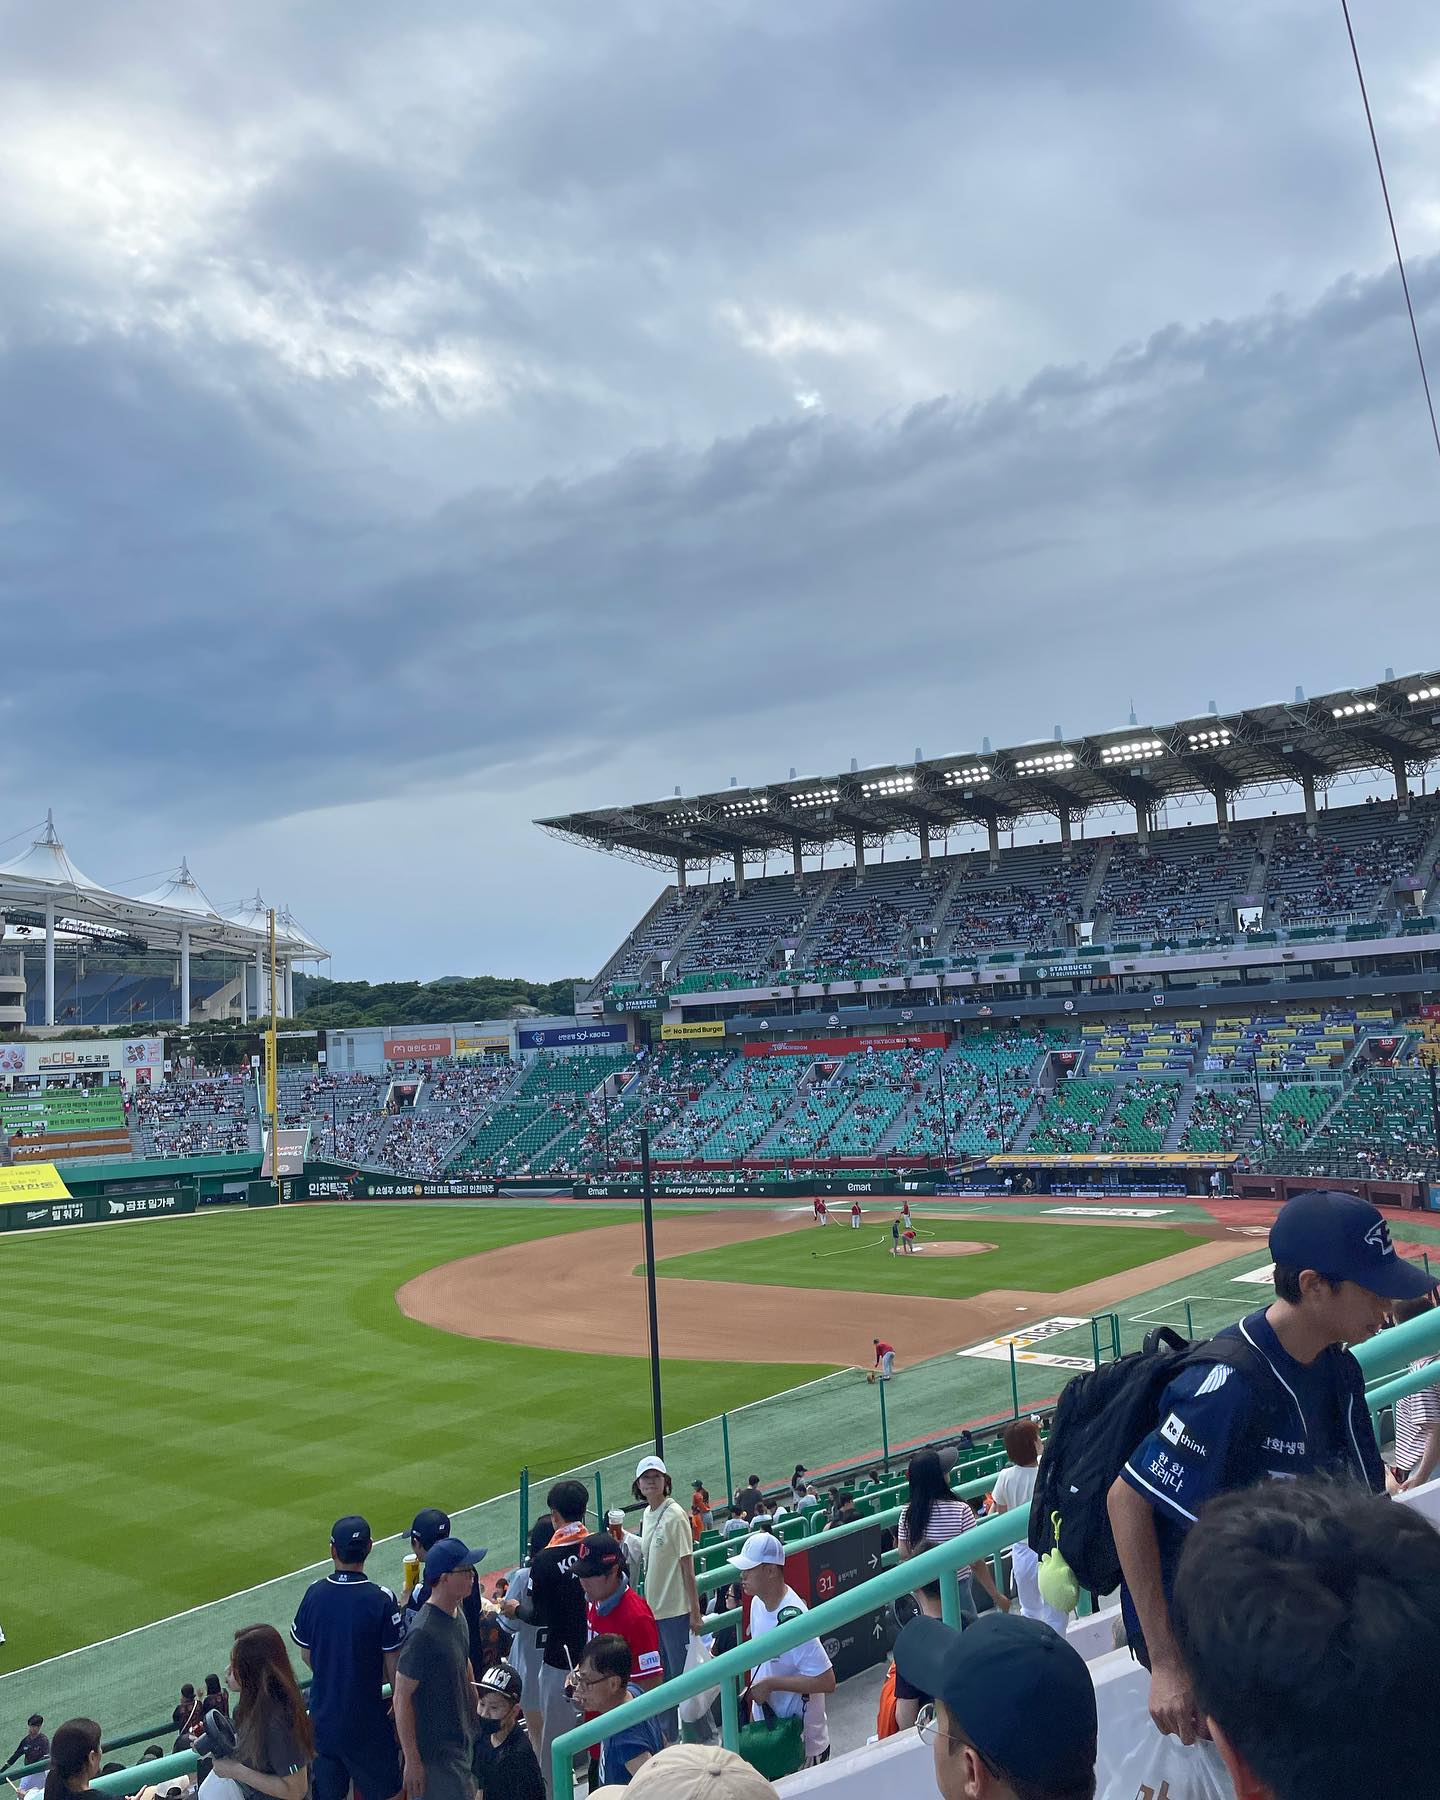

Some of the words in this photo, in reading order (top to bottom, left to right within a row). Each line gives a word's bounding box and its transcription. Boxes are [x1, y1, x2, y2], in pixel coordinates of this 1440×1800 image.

[1049, 964, 1092, 972] STARBUCKS
[625, 999, 656, 1007] STARBUCKS
[683, 1026, 701, 1034] Brand
[702, 1026, 723, 1034] Burger
[376, 1186, 394, 1195] 소성주
[395, 1186, 414, 1195] 소성주
[424, 1185, 436, 1195] 인천
[437, 1185, 450, 1194] 대표
[451, 1184, 468, 1194] 막걸리
[588, 1187, 608, 1196] emart
[665, 1186, 694, 1195] Everyday
[695, 1186, 714, 1195] lovely
[715, 1186, 736, 1195] place!
[847, 1182, 872, 1192] emart
[126, 1200, 147, 1212] 곰표
[148, 1197, 175, 1209] 밀가루
[52, 1207, 83, 1220] 밀워키
[1148, 1460, 1184, 1493] 포레나
[819, 1575, 835, 1593] 31
